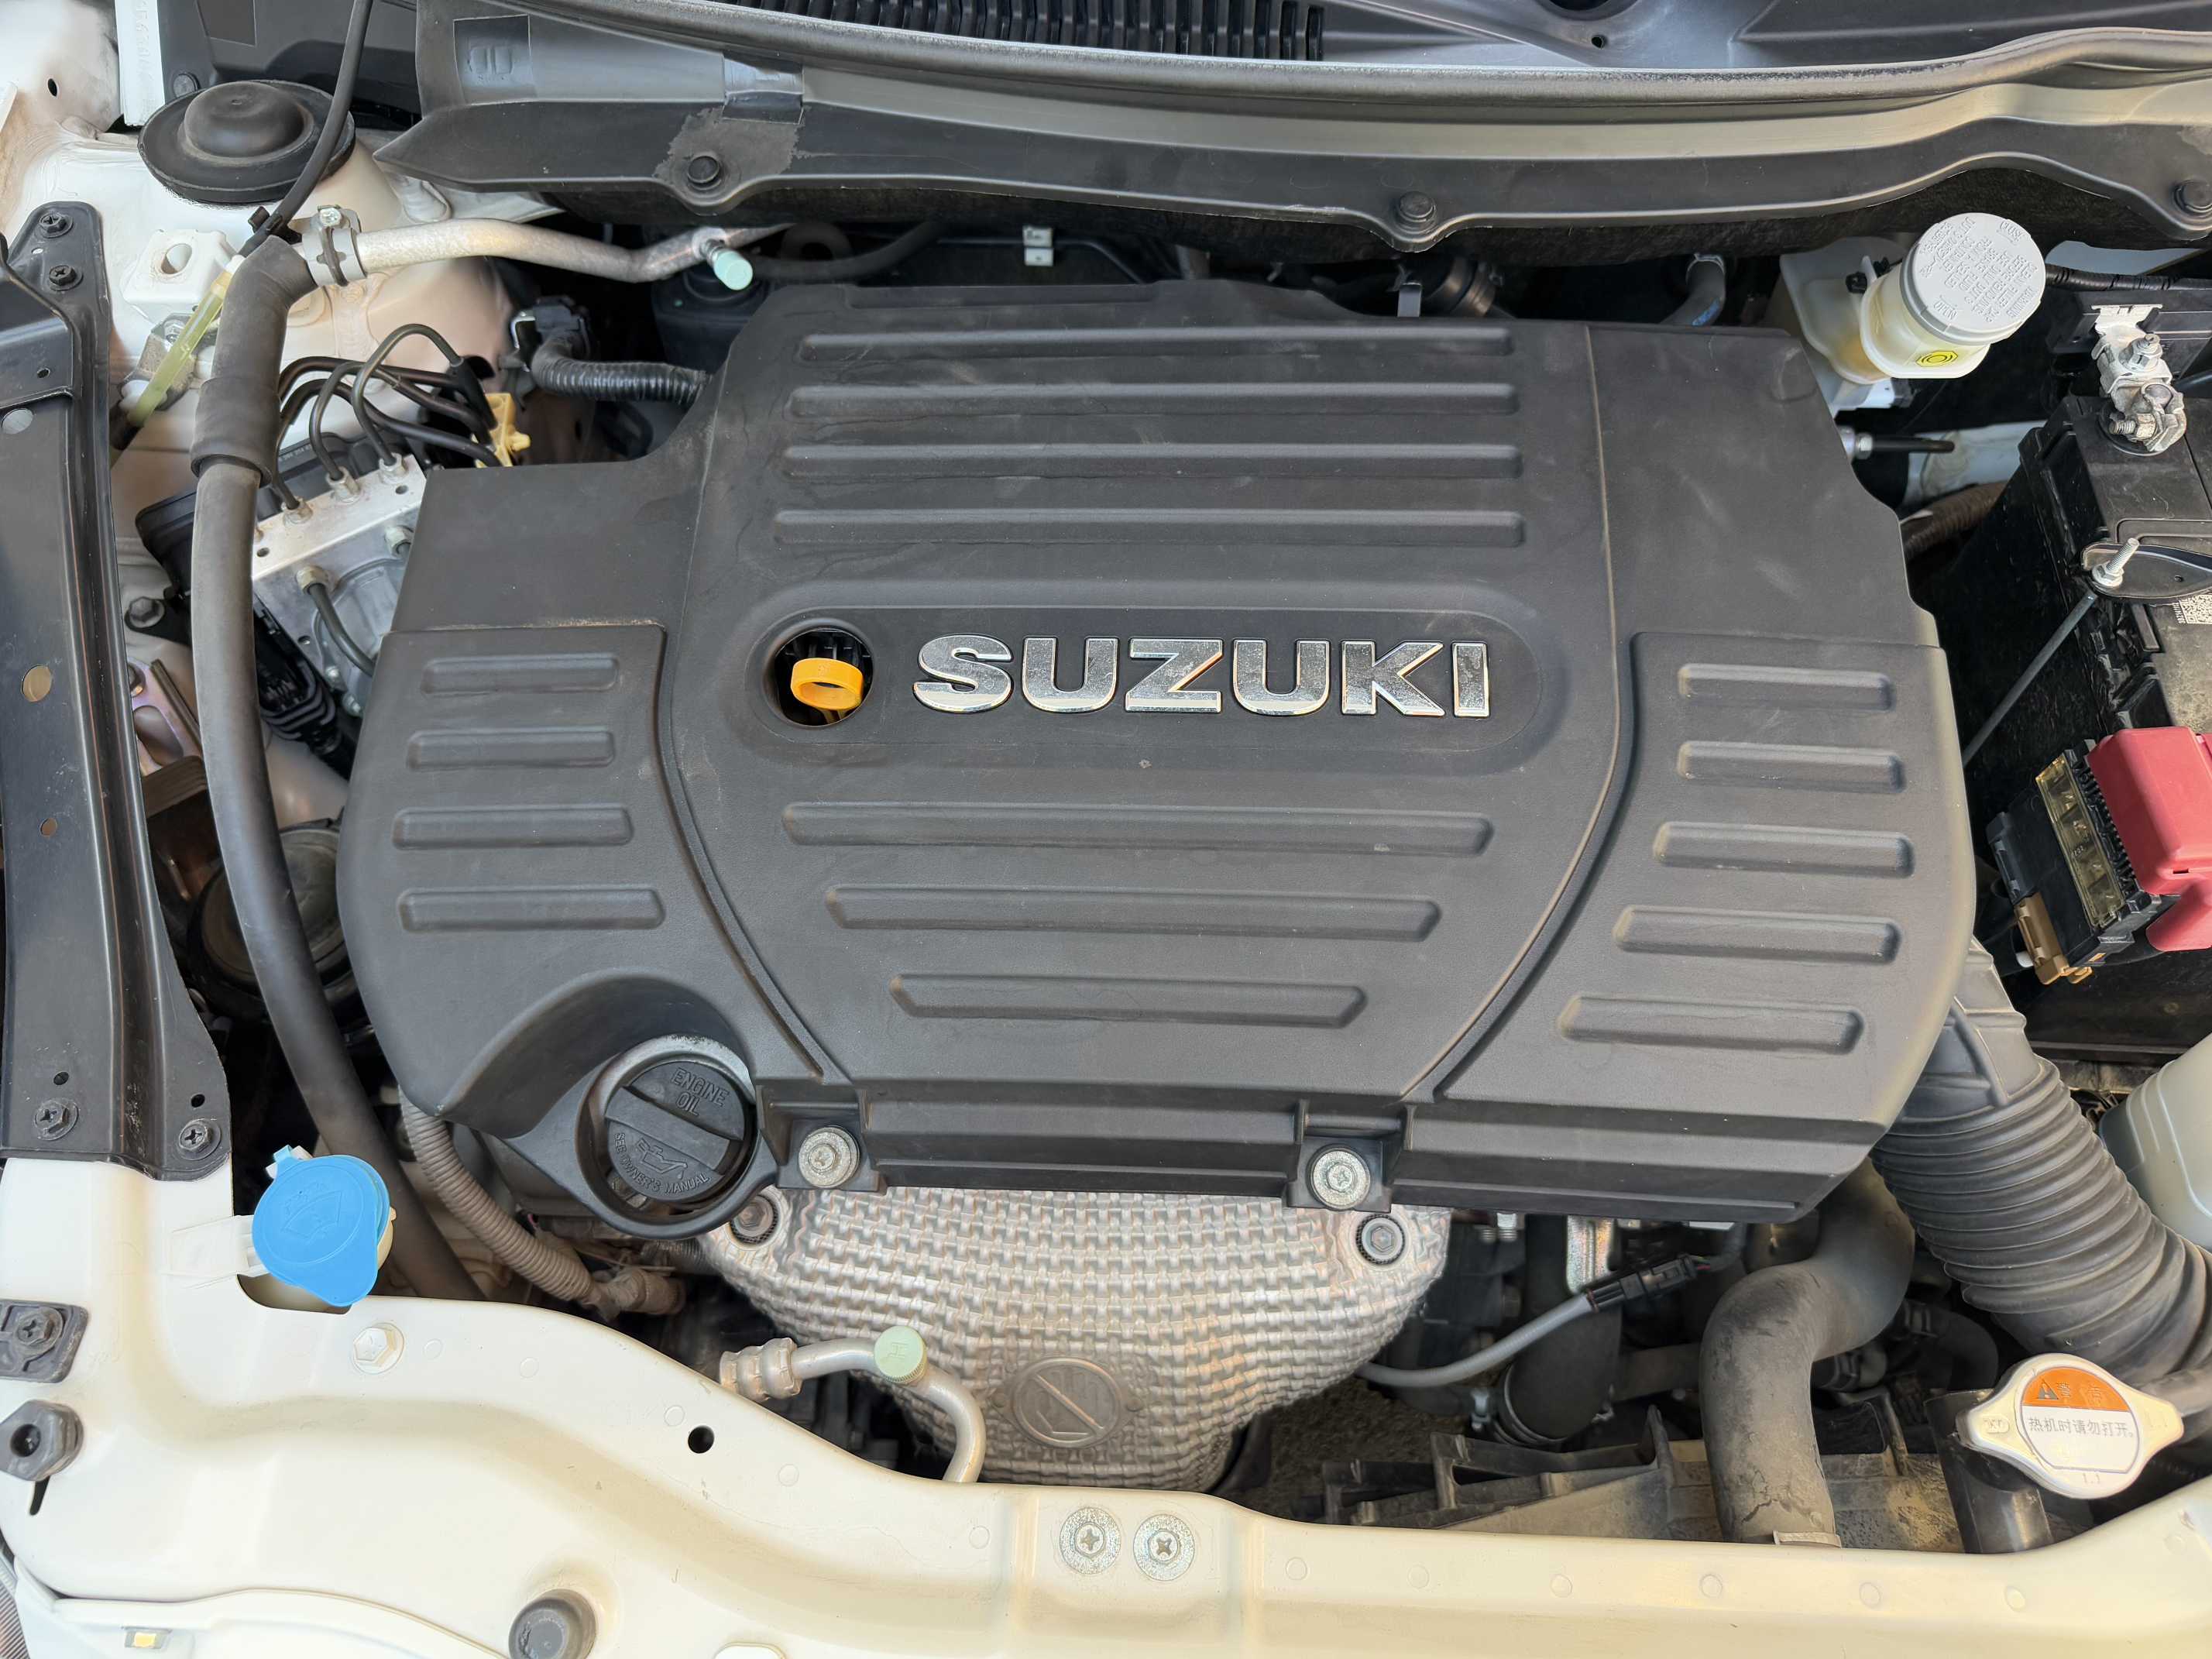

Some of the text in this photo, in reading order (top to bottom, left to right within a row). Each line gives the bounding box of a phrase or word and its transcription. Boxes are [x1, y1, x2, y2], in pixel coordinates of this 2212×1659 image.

[912, 634, 1491, 717] SUZUKI
[670, 1066, 729, 1108] ENGINE
[675, 1092, 700, 1117] OIL
[614, 1132, 710, 1194] SEE OWNER'S MANUAL
